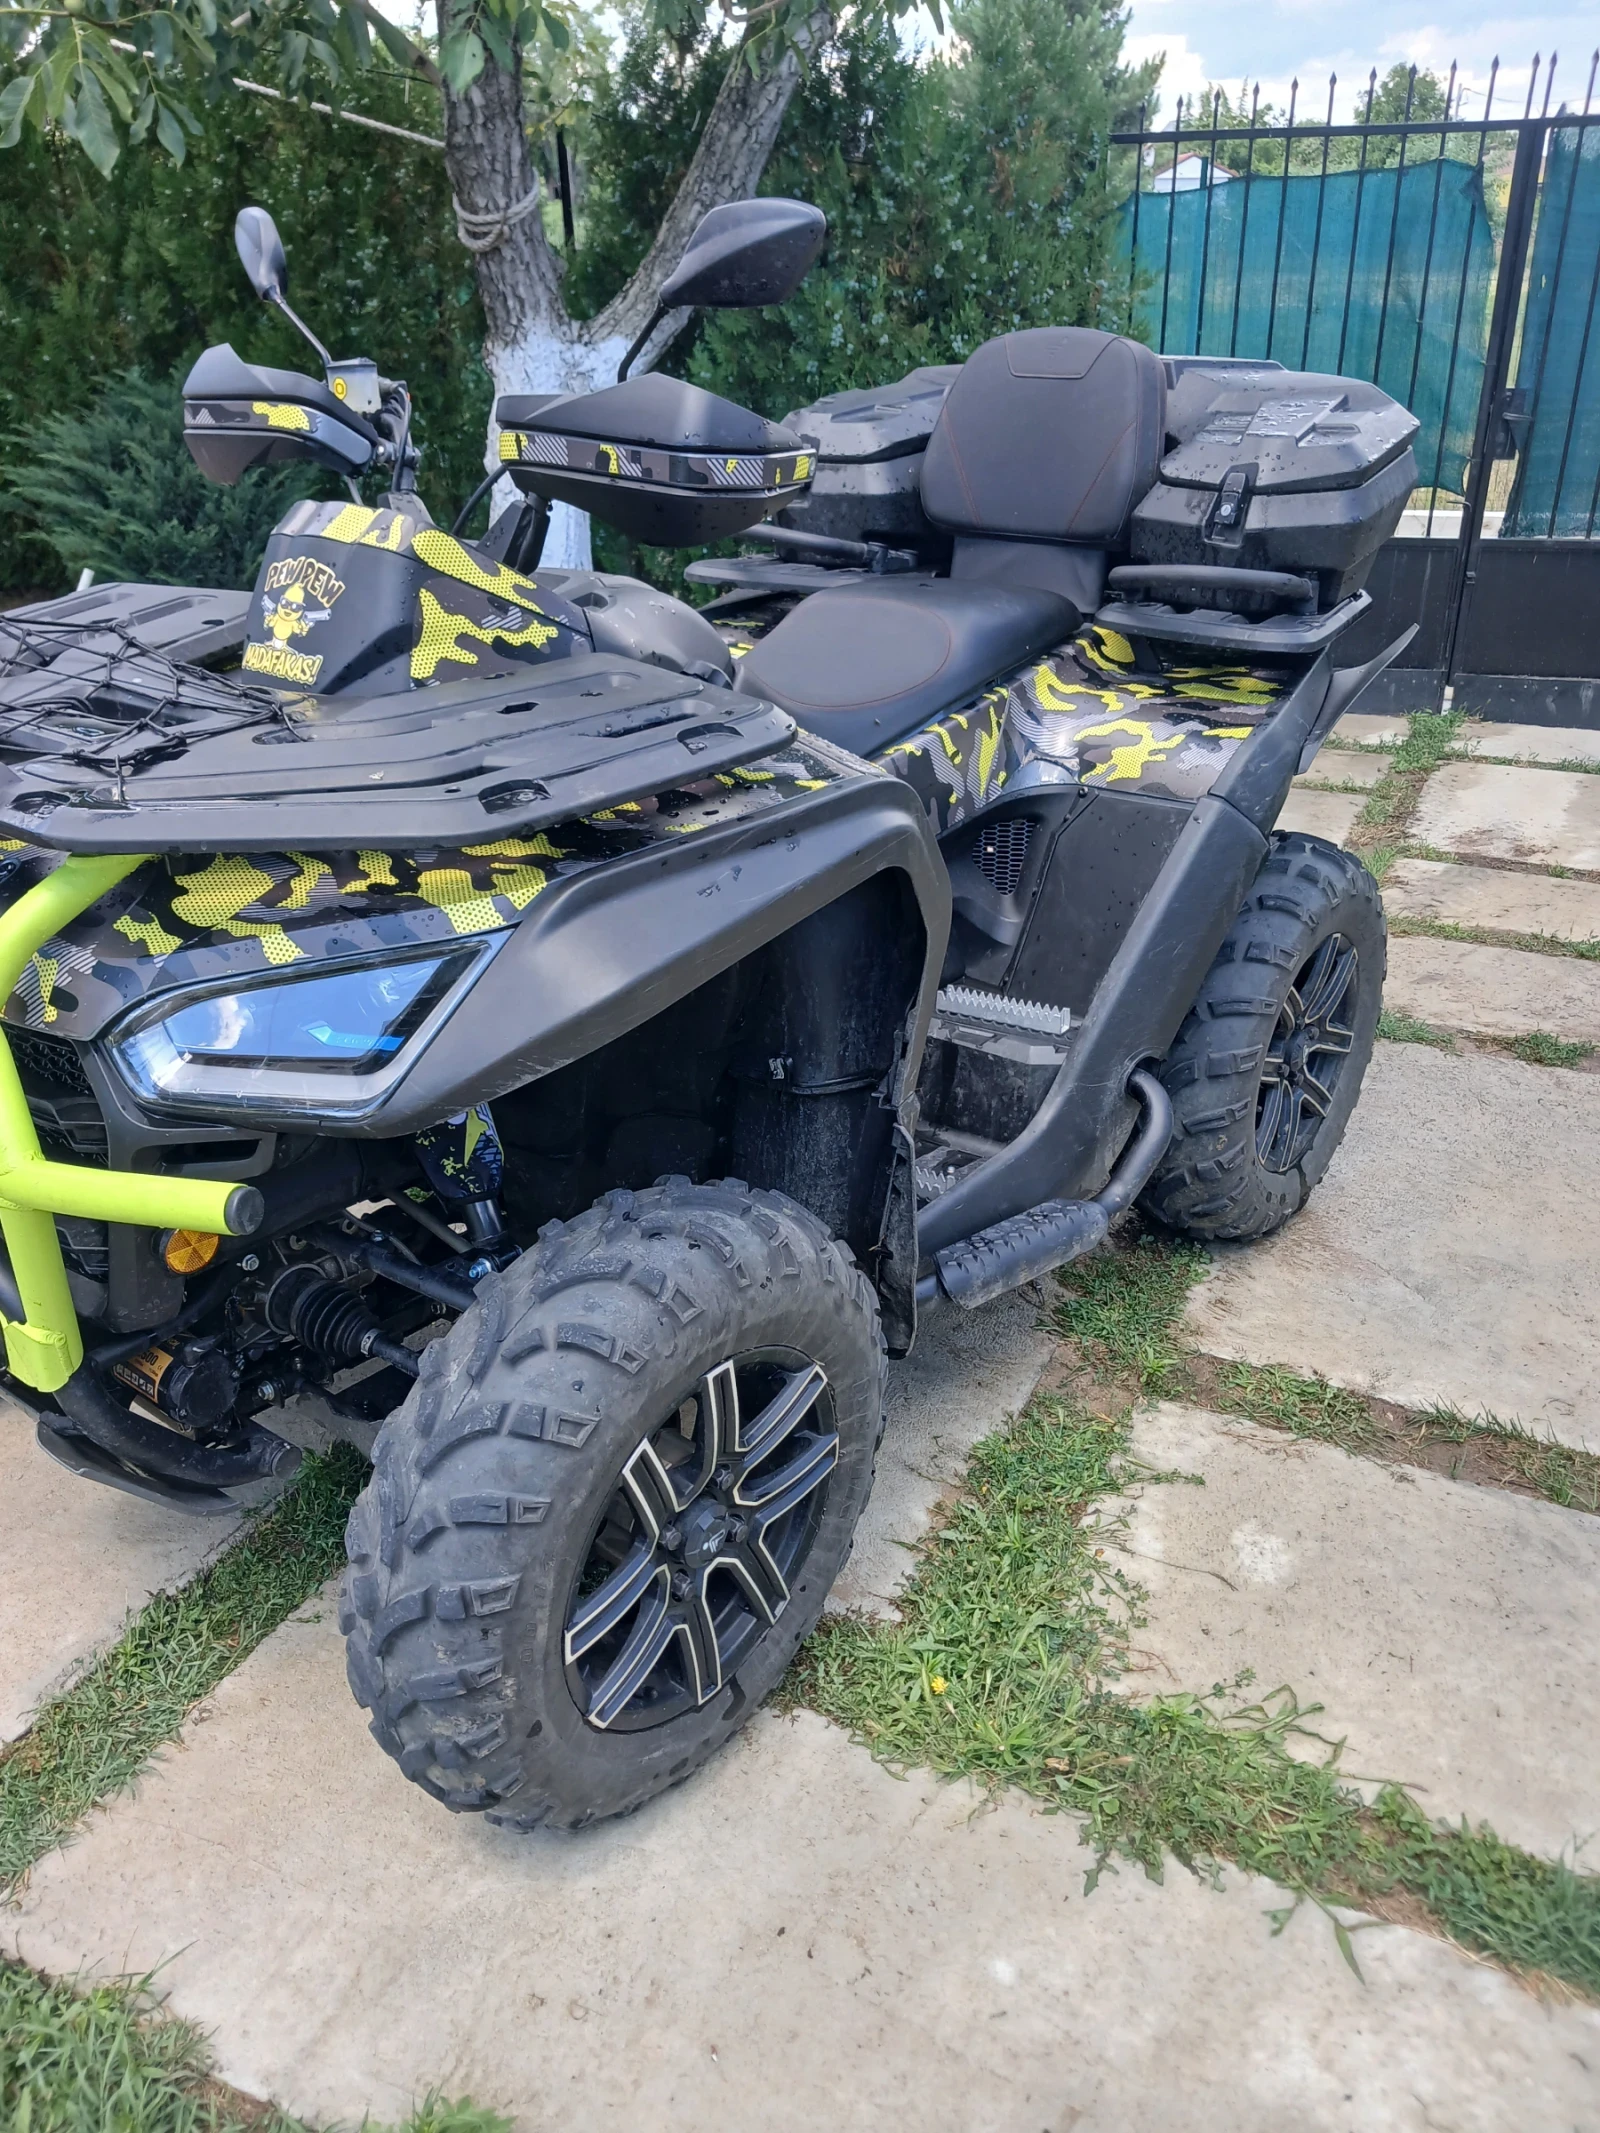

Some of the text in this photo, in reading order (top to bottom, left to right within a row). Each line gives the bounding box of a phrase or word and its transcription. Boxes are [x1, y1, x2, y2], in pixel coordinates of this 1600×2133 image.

[264, 556, 345, 608] PEW PEW
[242, 642, 324, 685] MADAFAKAS!
[138, 1351, 159, 1366] 500
